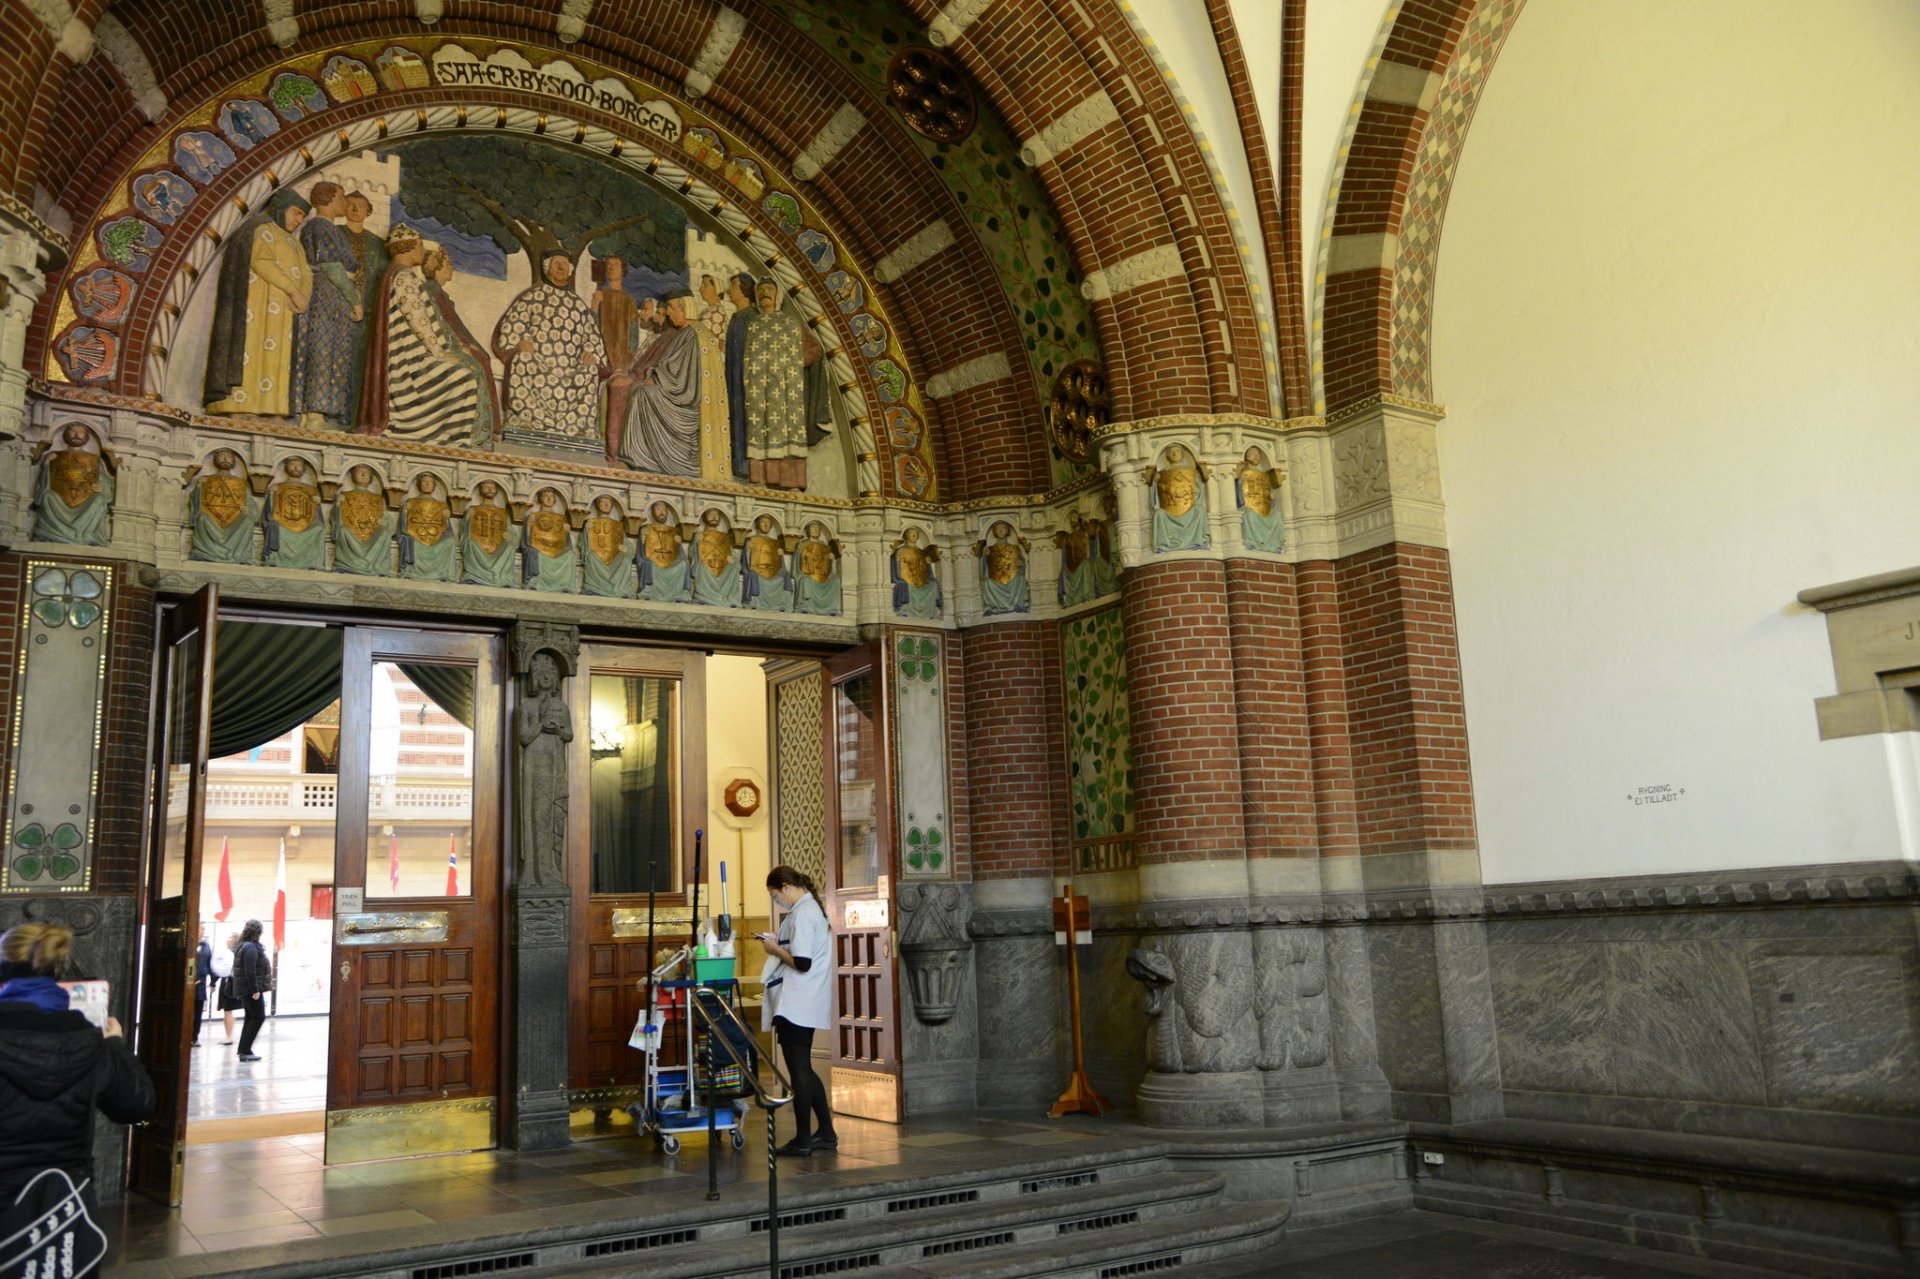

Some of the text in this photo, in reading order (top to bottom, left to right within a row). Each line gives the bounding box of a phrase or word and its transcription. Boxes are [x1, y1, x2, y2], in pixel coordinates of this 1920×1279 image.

[599, 90, 676, 140] BORGER
[1644, 793, 1678, 804] TILLADT
[60, 1231, 75, 1279] adidas
